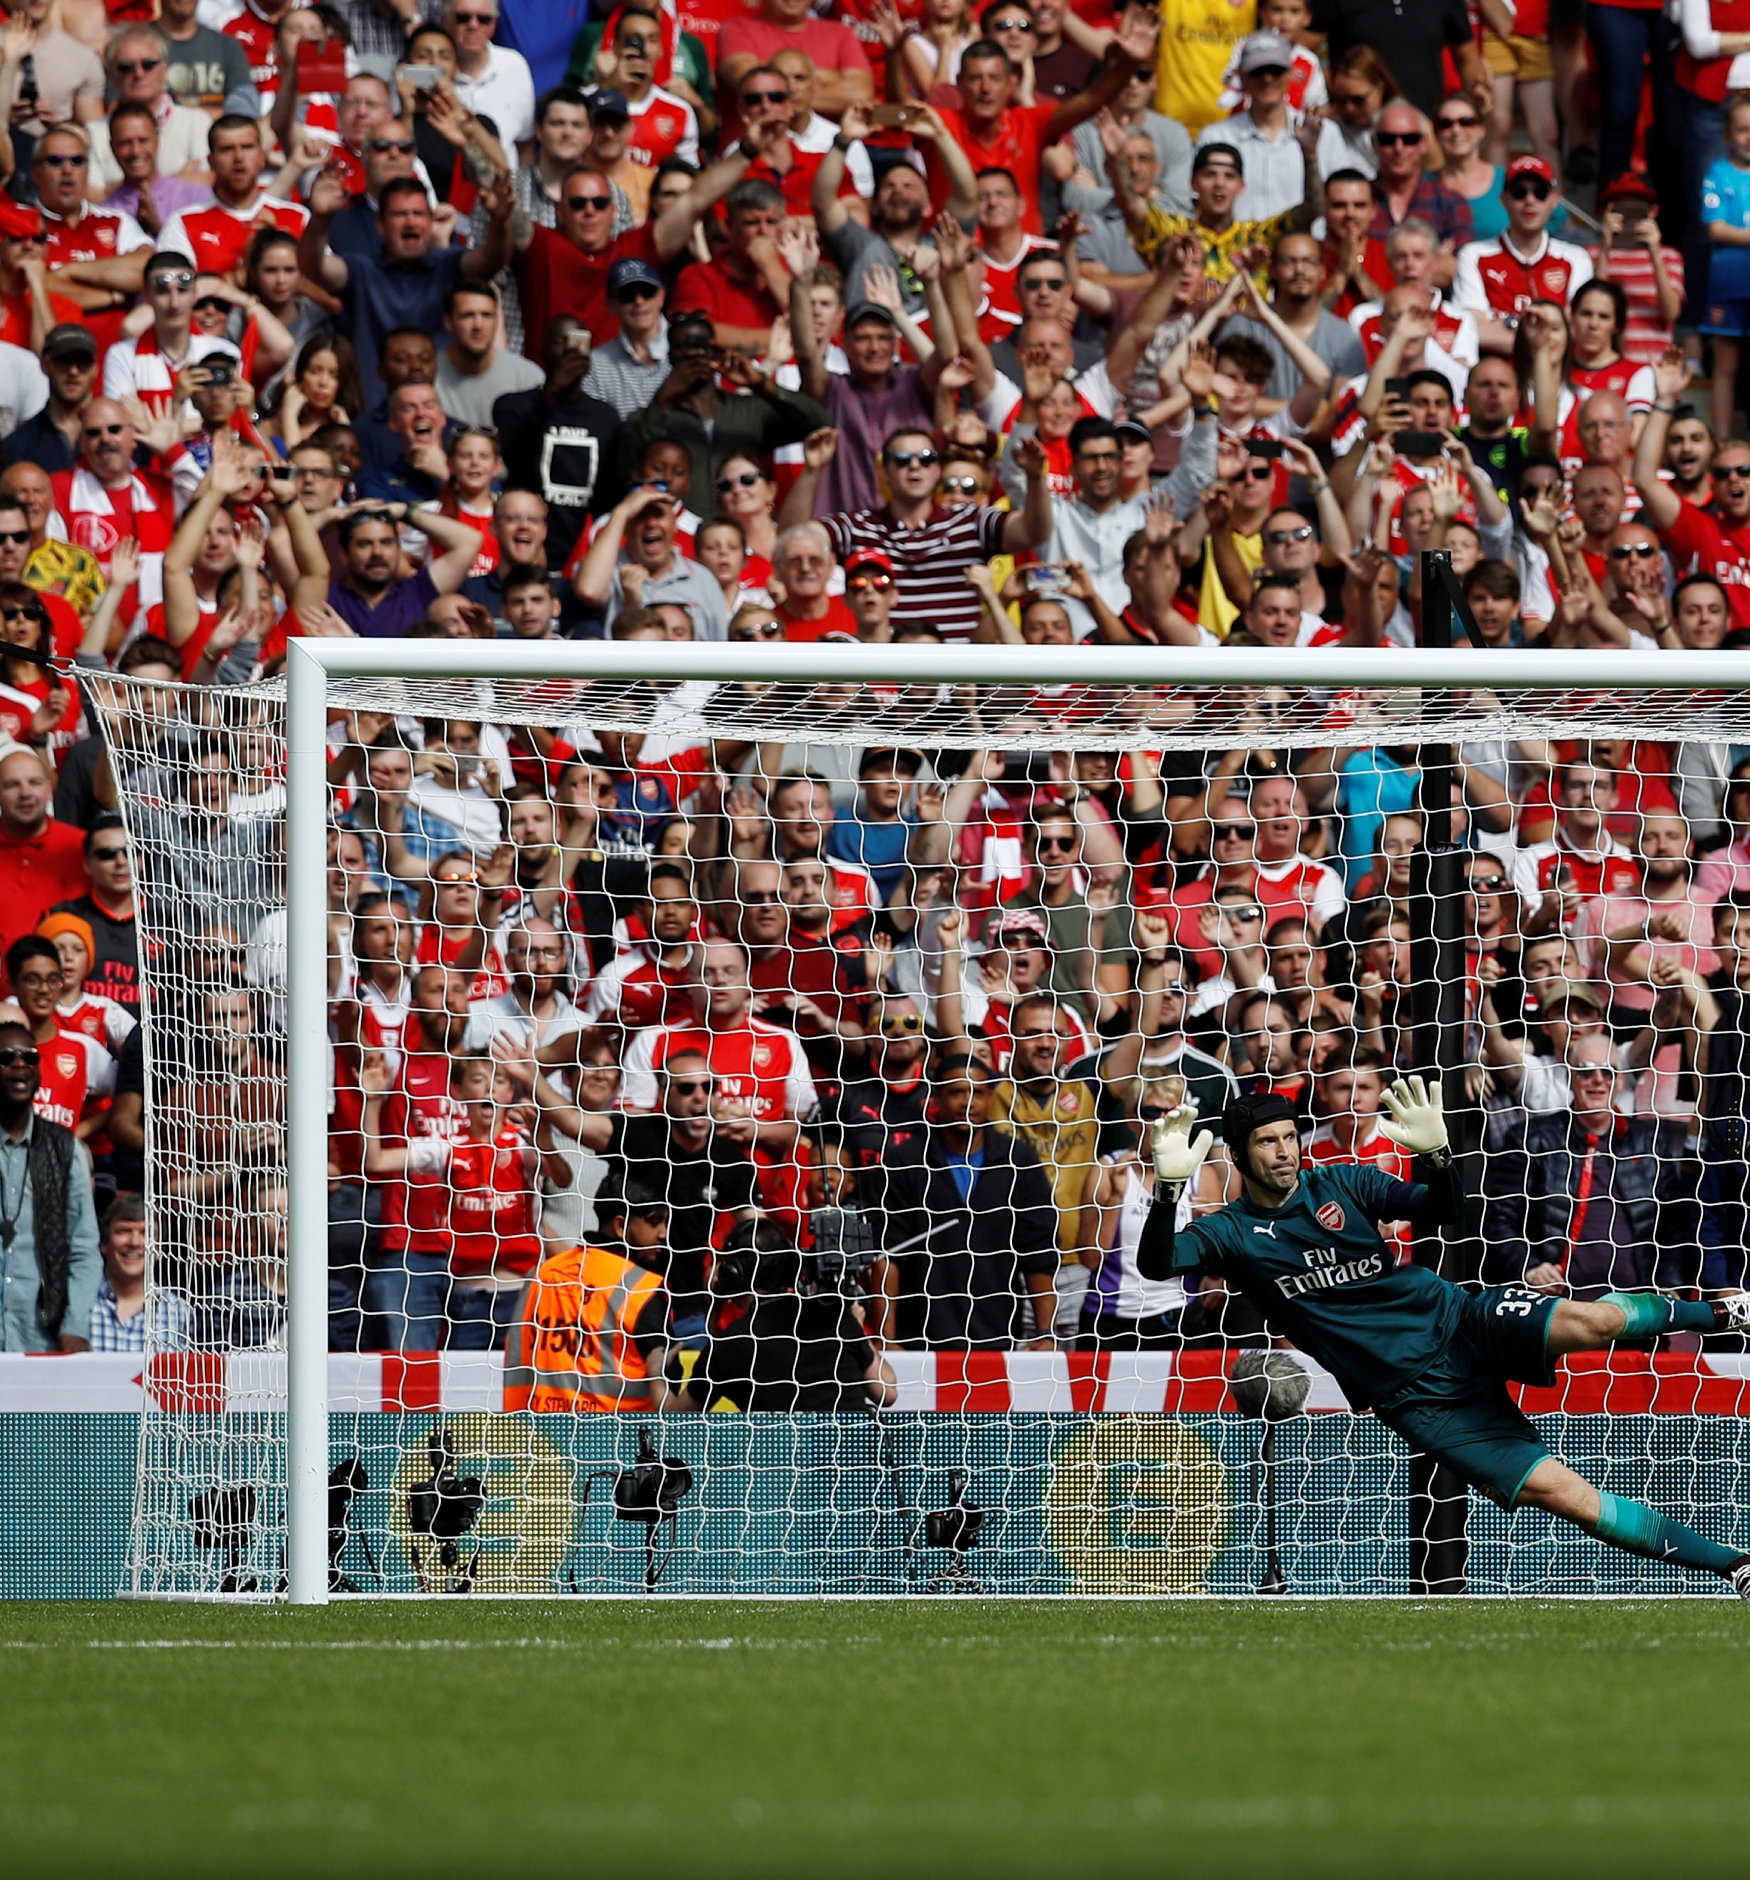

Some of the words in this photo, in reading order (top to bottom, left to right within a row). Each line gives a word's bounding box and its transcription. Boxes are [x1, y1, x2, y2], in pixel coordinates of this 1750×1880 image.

[103, 960, 135, 982] Fly
[413, 1109, 472, 1136] Emir
[1302, 1245, 1337, 1266] Fly
[1274, 1252, 1384, 1300] Emirates
[1495, 1287, 1542, 1317] 33
